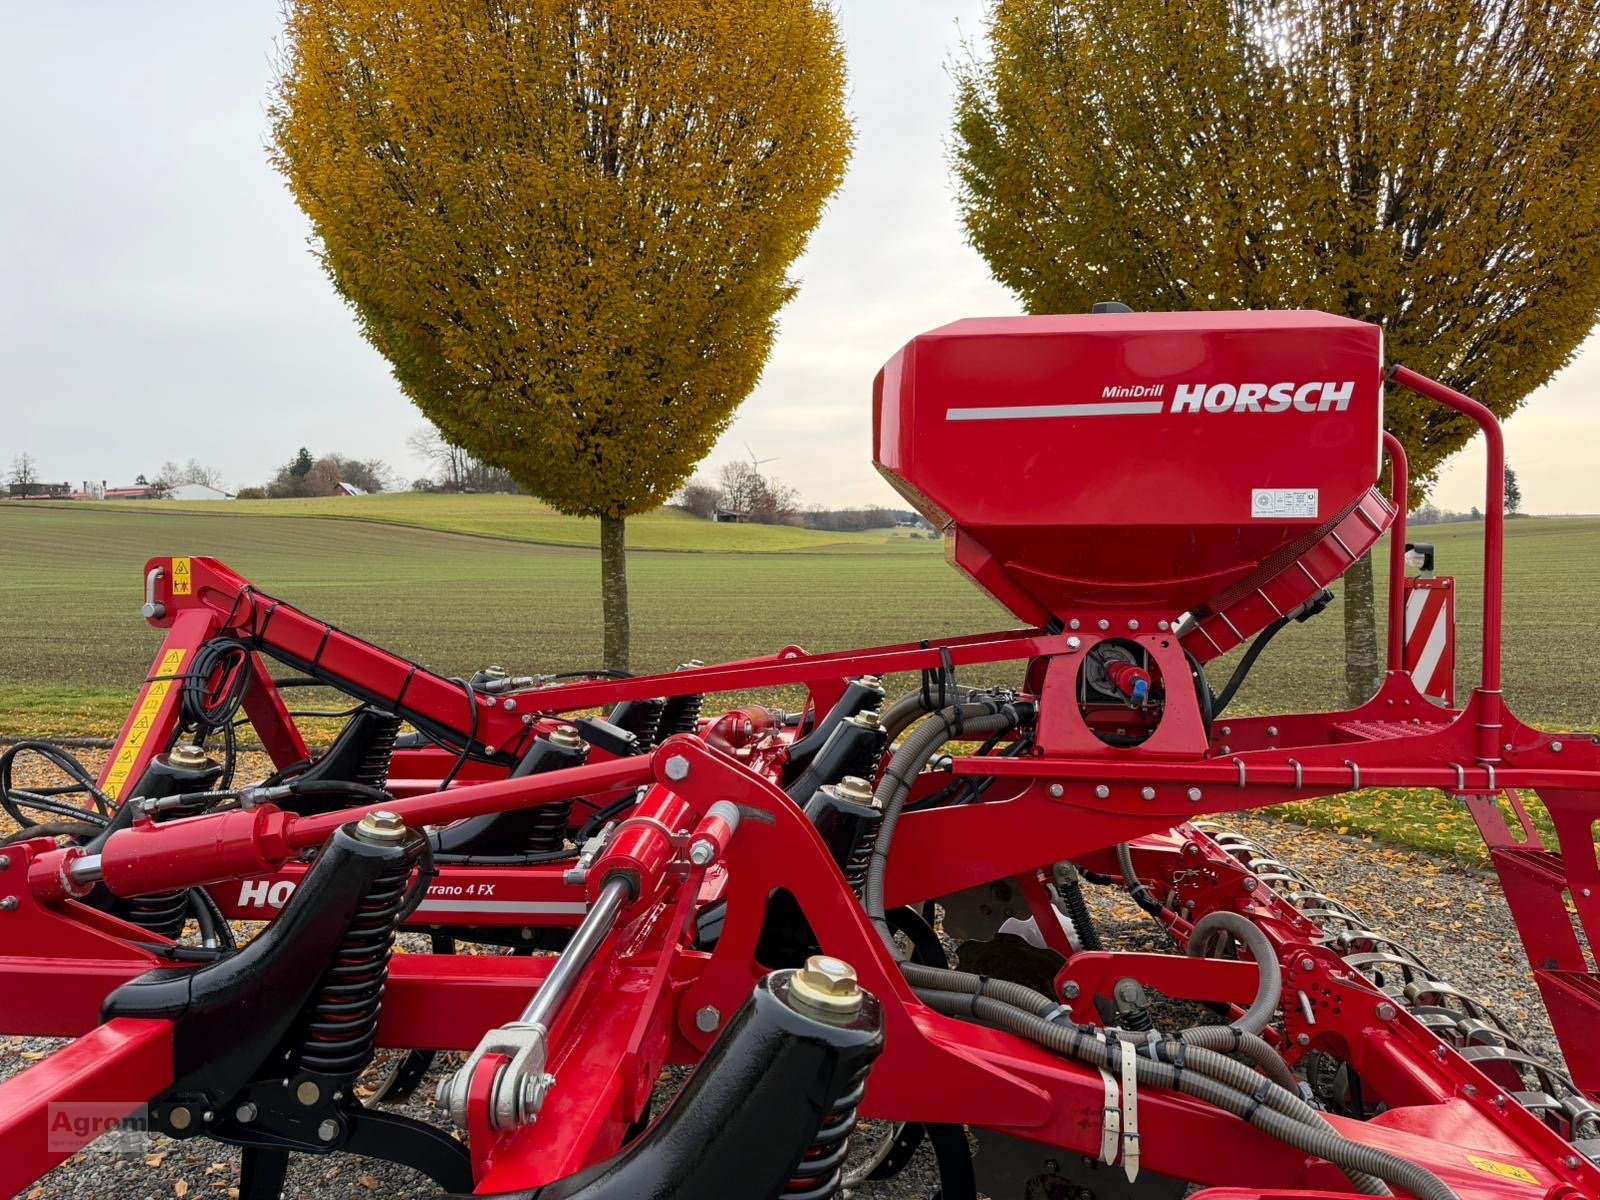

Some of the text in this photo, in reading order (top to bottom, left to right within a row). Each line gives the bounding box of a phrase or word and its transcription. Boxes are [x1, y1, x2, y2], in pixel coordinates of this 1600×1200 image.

[1101, 381, 1356, 414] MiniDrill HORSCH
[237, 880, 297, 909] HO
[426, 884, 496, 895] rrano 4 FX
